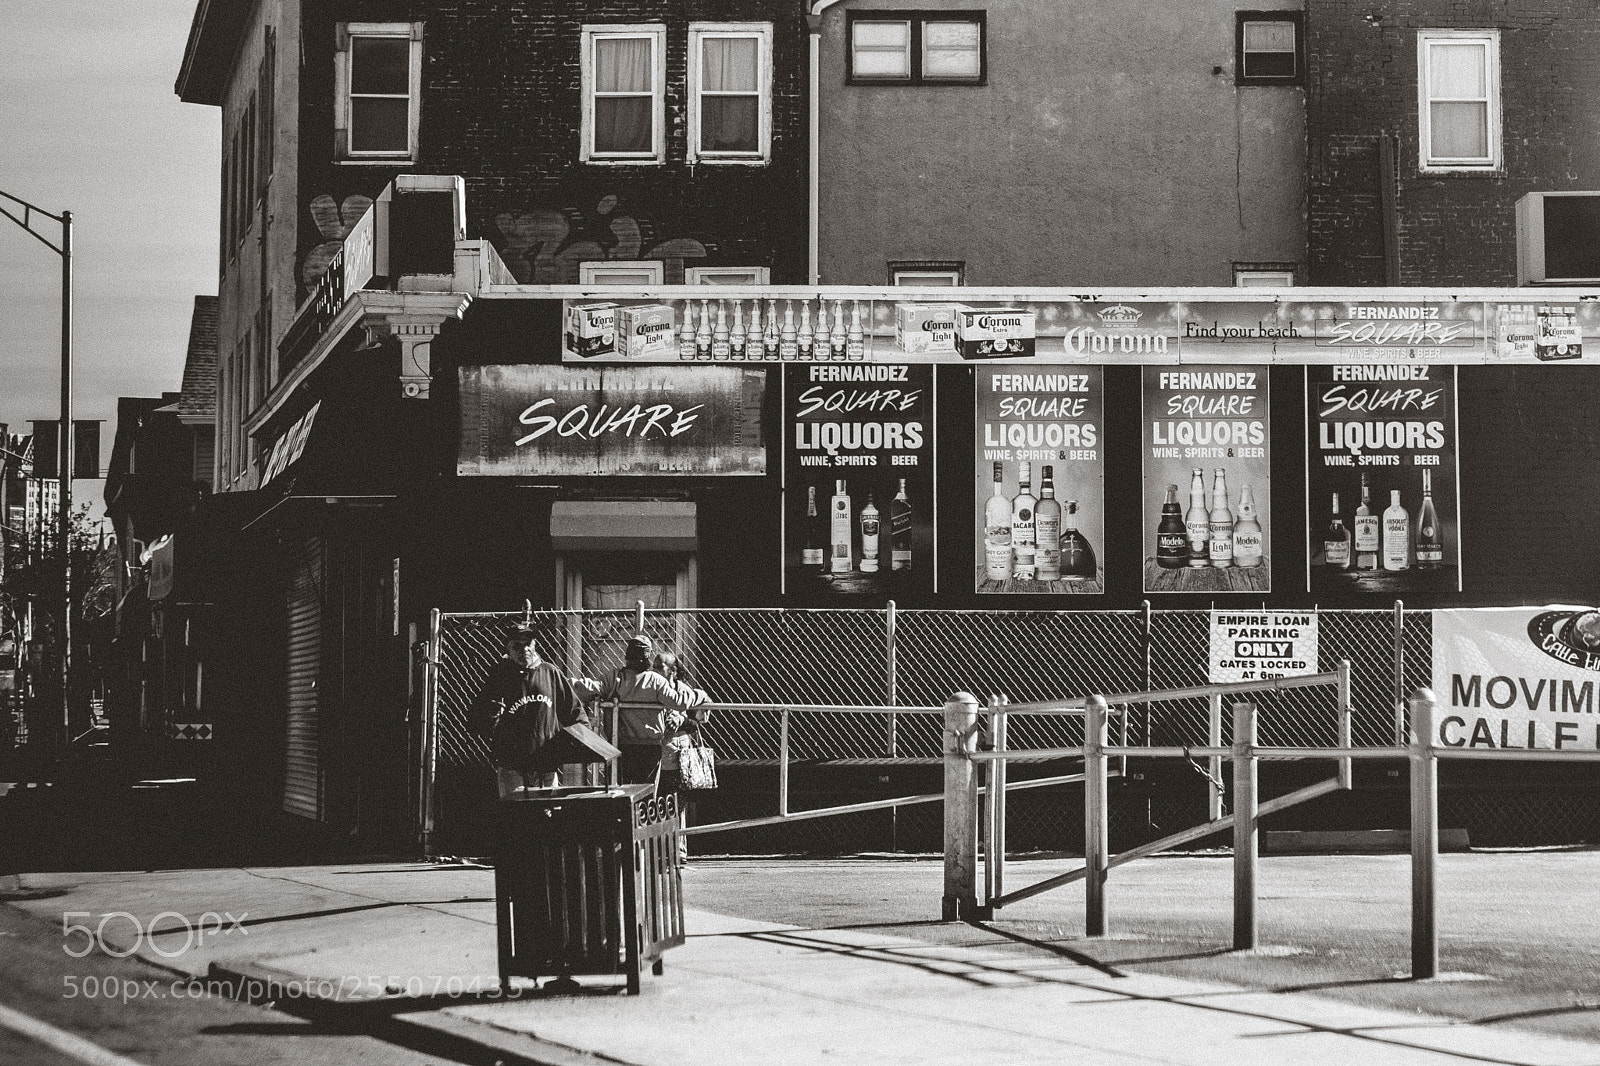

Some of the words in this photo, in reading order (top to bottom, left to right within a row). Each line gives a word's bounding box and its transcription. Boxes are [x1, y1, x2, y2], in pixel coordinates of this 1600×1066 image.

[1348, 307, 1440, 320] FERNANDEZ
[591, 316, 614, 328] Coro
[636, 322, 670, 336] Corona
[922, 320, 954, 332] Coron
[978, 316, 1021, 330] Corona
[932, 332, 952, 342] Light
[1186, 320, 1218, 338] Find
[1221, 328, 1255, 343] your
[1259, 320, 1302, 338] beach.
[1328, 322, 1468, 344] SQUARE
[646, 334, 663, 344] Light
[1064, 326, 1168, 362] Corona
[1374, 349, 1406, 359] SPIRITS
[1409, 348, 1416, 358] &
[1418, 349, 1442, 359] BEER
[810, 366, 908, 382] FERNANDEZ
[1332, 365, 1430, 381] FERNANDEZ
[992, 374, 1089, 392] FERNANDEZ
[1160, 372, 1256, 390] FERNANDEZ
[796, 385, 922, 418] SQUARE
[1000, 396, 1089, 420] SQUARE
[1167, 394, 1256, 418] SQUARE
[1320, 384, 1443, 418] SQUARE
[514, 398, 704, 447] SQUARE
[796, 422, 924, 456] LIQUORS
[984, 423, 1097, 448] LIQUORS
[1152, 420, 1265, 446] LIQUORS
[1320, 421, 1445, 456] LIQUORS
[984, 450, 1014, 462] WINE,
[1016, 450, 1056, 460] SPIRITS
[1059, 450, 1066, 460] &
[1070, 450, 1097, 460] BEER
[1152, 448, 1182, 460] WINE,
[1184, 448, 1225, 458] SPIRITS
[1227, 448, 1234, 458] &
[1238, 448, 1265, 458] BEER
[1324, 455, 1356, 468] WINE,
[1358, 454, 1400, 466] SPIRITS
[1414, 455, 1440, 466] BEER
[800, 456, 832, 468] WINE,
[834, 455, 878, 466] SPIRITS
[891, 456, 918, 466] BEER
[1160, 536, 1184, 547] Modelo
[1236, 536, 1258, 546] Modelo
[1218, 616, 1268, 626] EMPIRE
[1274, 616, 1310, 626] LOAN
[1228, 628, 1300, 638] PARKING
[1237, 642, 1289, 656] ONLY
[1220, 660, 1256, 668] GATES
[1260, 660, 1306, 669] LOCKED
[1242, 671, 1256, 679] AT
[1452, 673, 1600, 714] MOVIM
